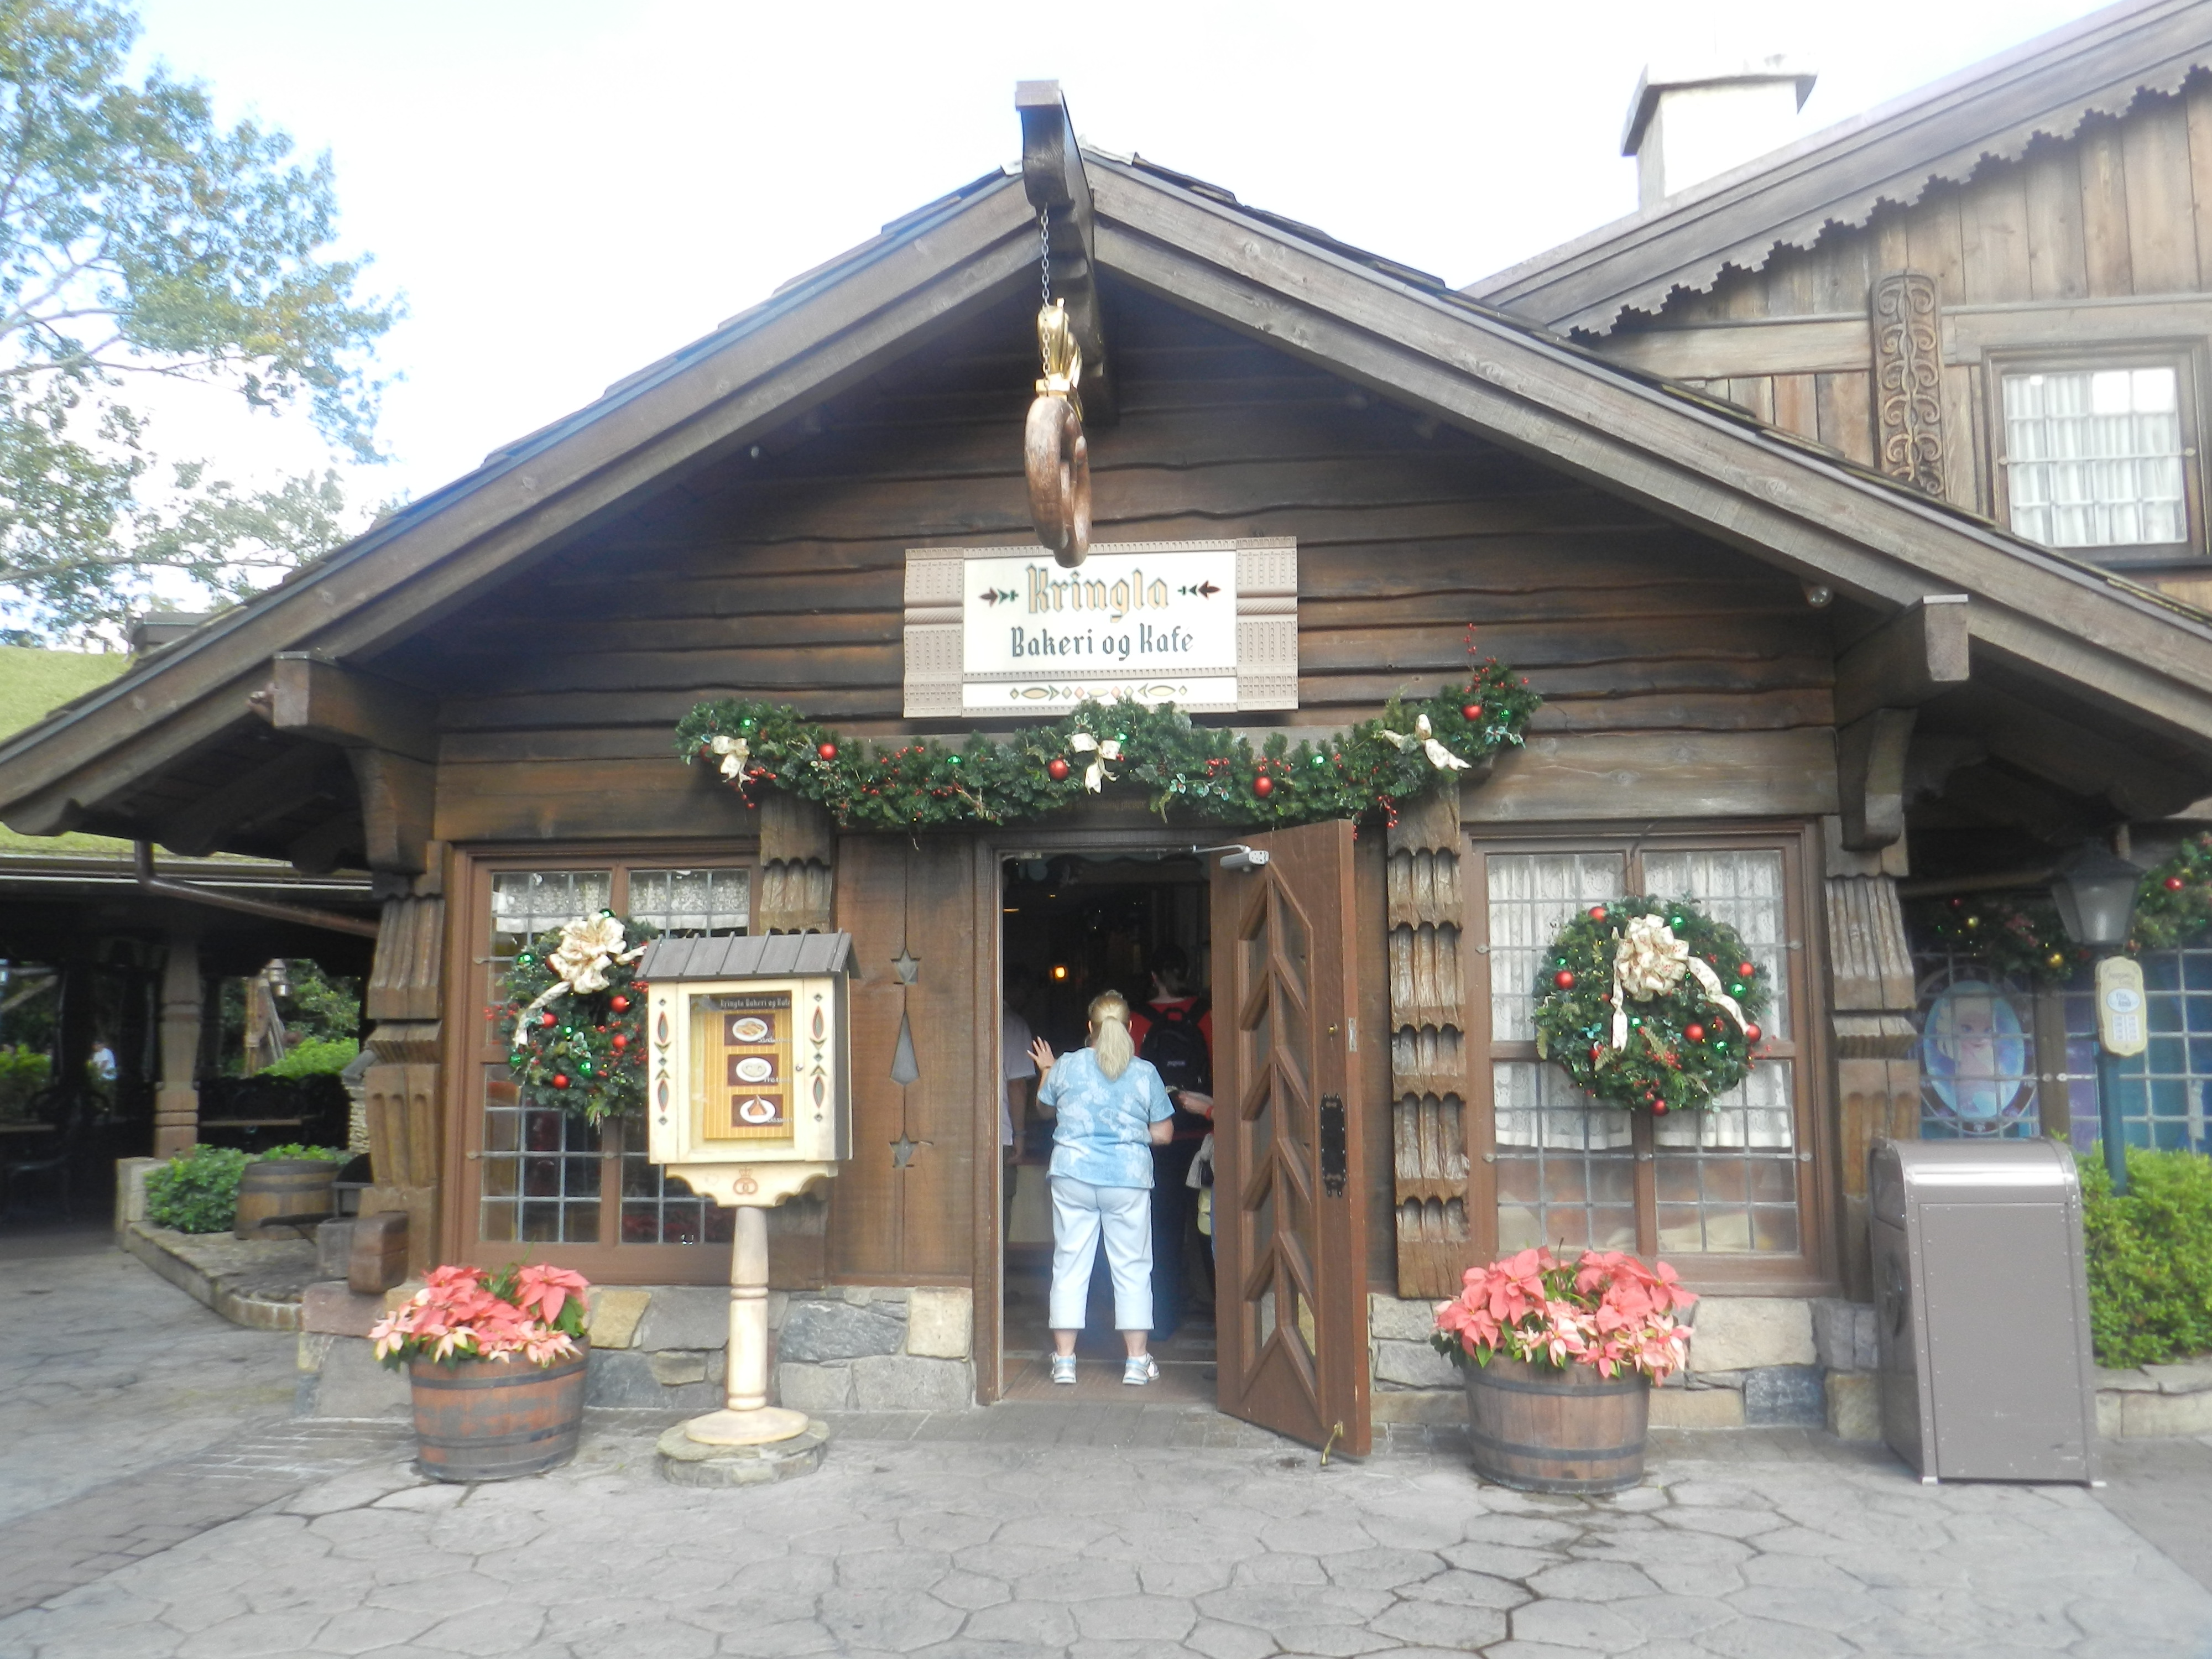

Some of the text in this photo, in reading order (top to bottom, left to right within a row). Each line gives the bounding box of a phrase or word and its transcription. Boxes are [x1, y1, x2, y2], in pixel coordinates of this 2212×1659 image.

[1025, 563, 1169, 623] Kringla
[1011, 626, 1093, 657] Bakeri
[1103, 634, 1130, 661] og
